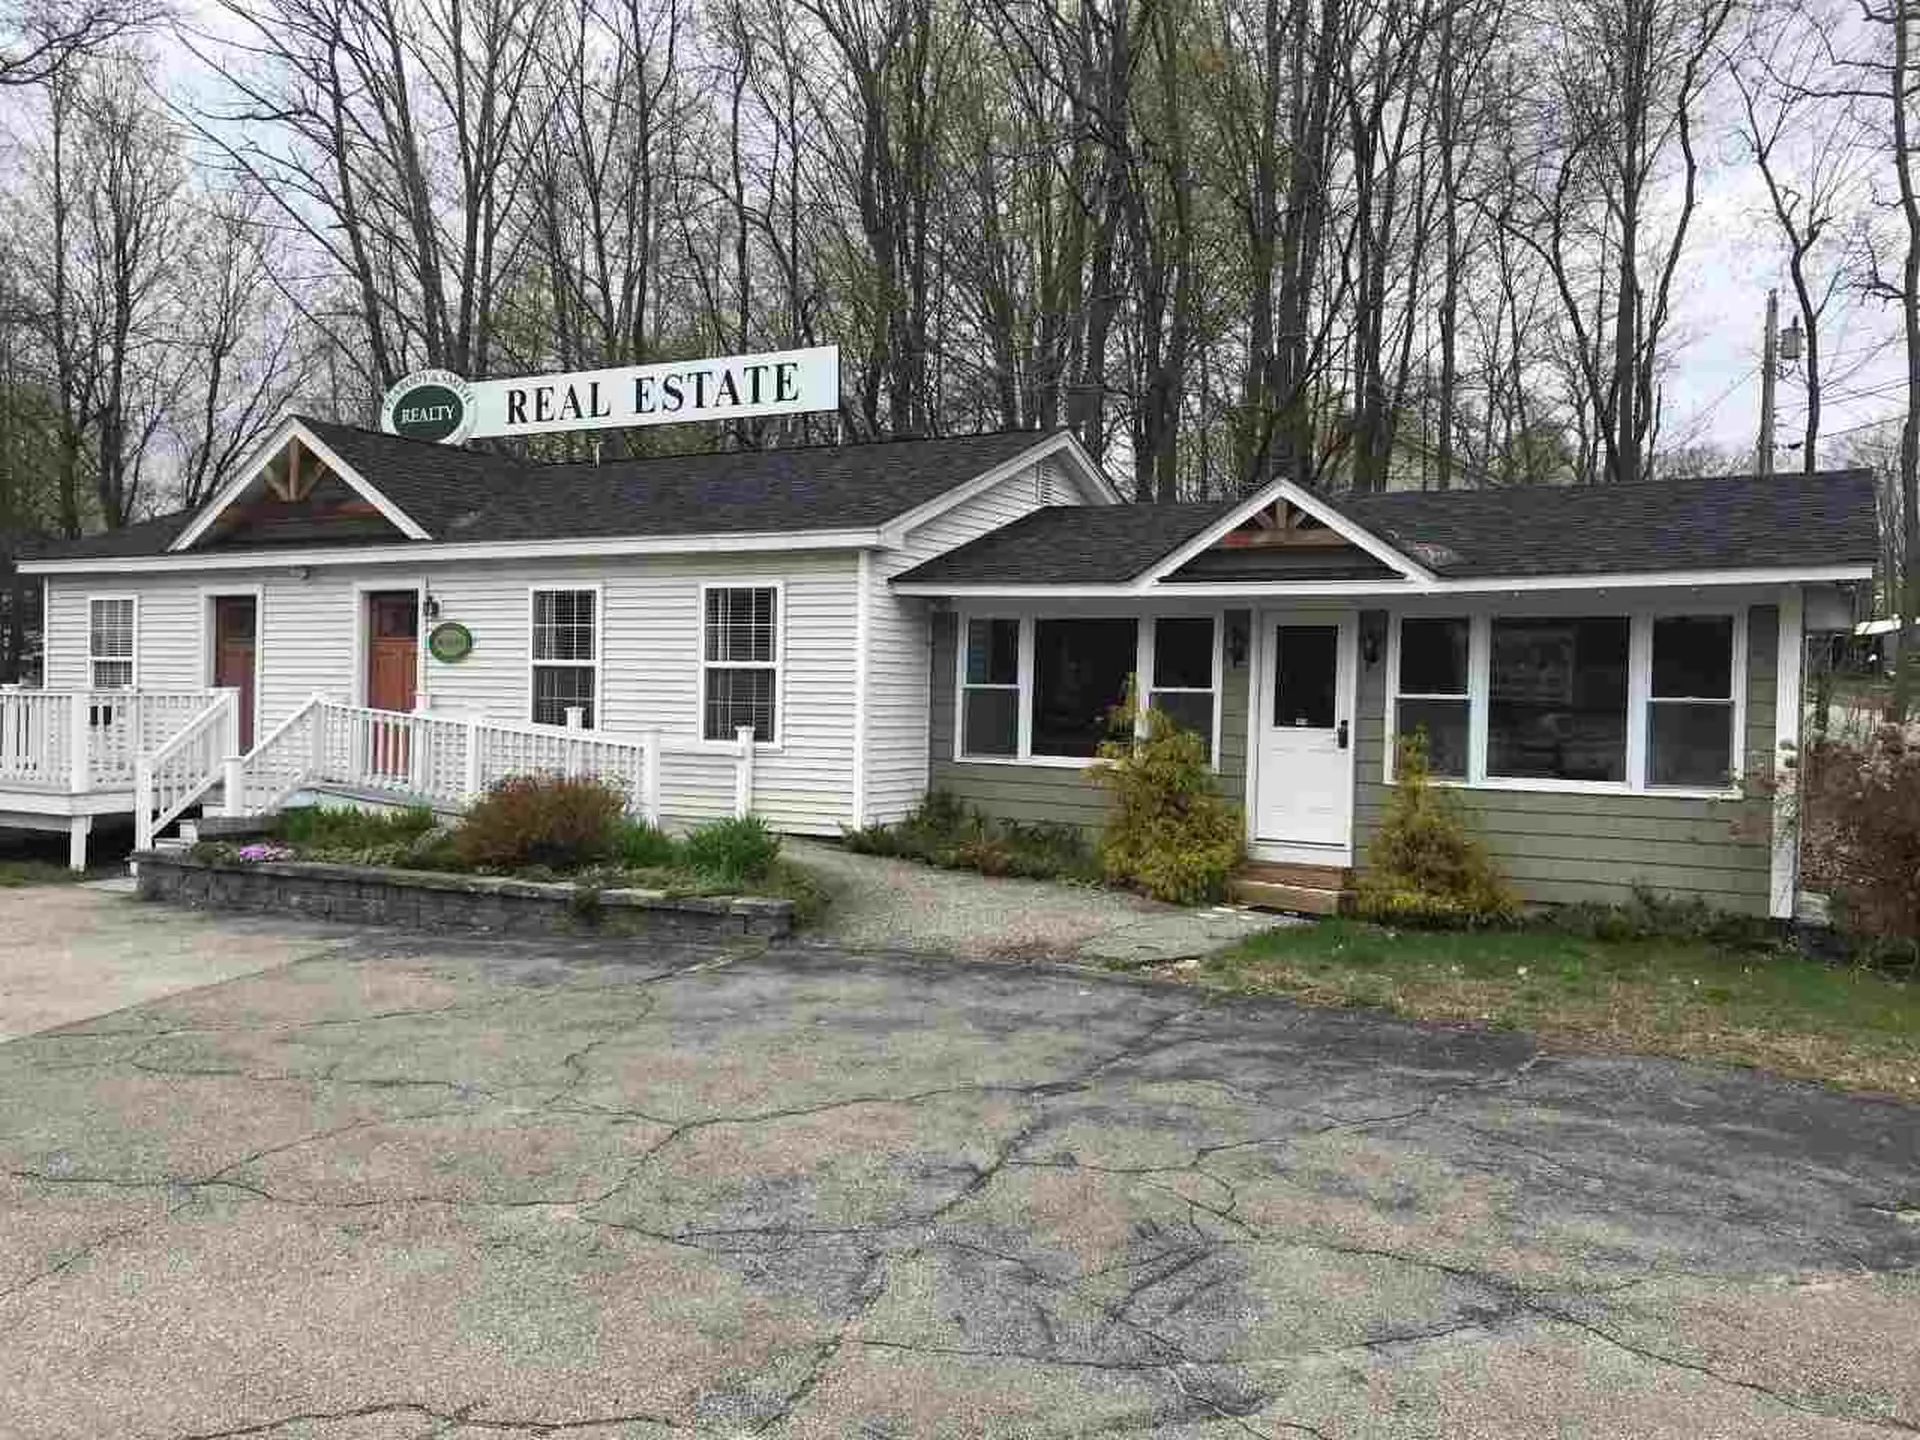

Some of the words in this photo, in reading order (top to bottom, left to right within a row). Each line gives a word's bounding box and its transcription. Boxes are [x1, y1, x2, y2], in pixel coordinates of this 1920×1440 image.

[506, 381, 611, 424] REAL
[633, 362, 799, 414] ESTATE
[402, 405, 456, 423] REALTY
